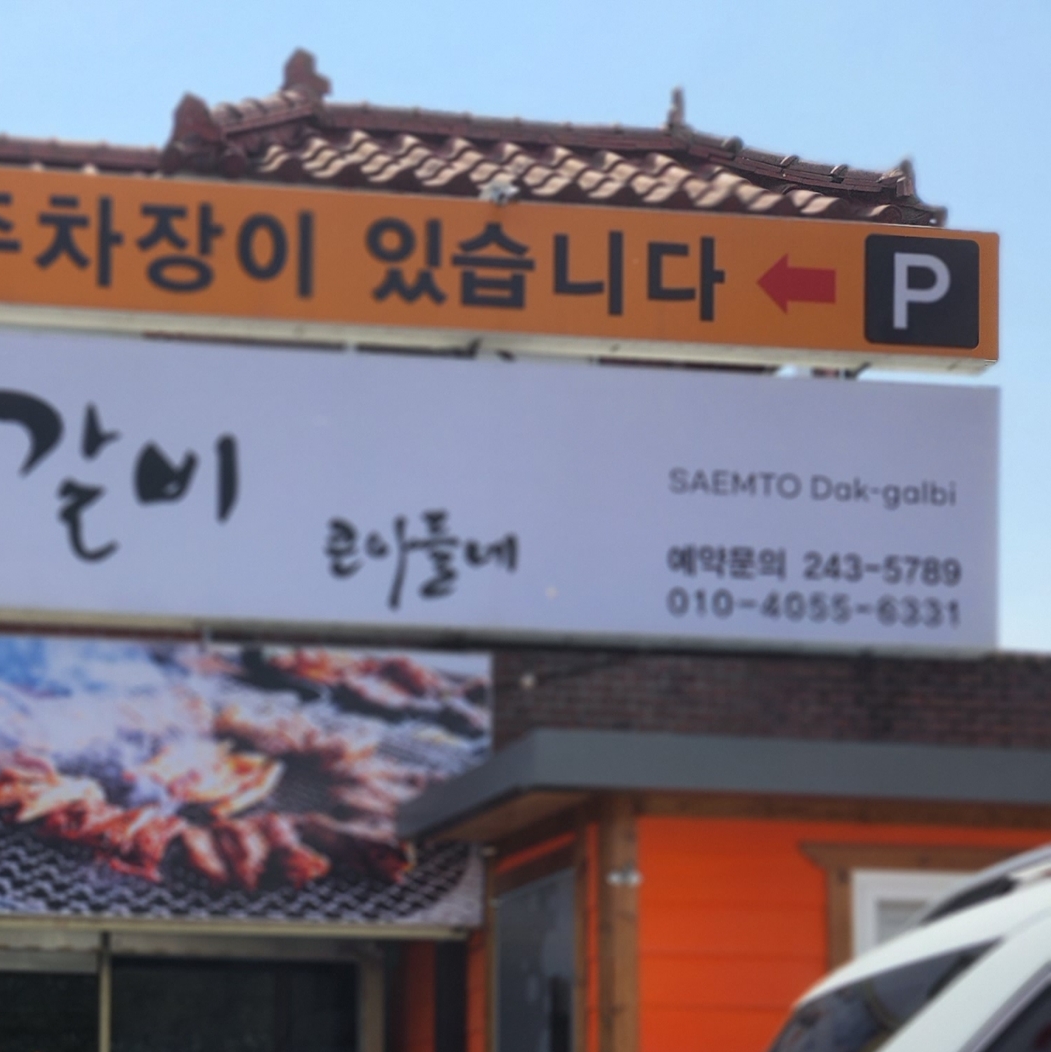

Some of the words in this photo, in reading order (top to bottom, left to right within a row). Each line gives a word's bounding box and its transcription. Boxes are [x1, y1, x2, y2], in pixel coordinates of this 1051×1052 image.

[364, 217, 726, 323] 있습니다
[892, 251, 951, 331] P
[667, 467, 803, 500] SAEMTO
[810, 474, 957, 510] Dak-galbi
[666, 545, 787, 581] 예약문의
[802, 551, 963, 588] 243-5789
[666, 587, 961, 629] 010-4055-6331
